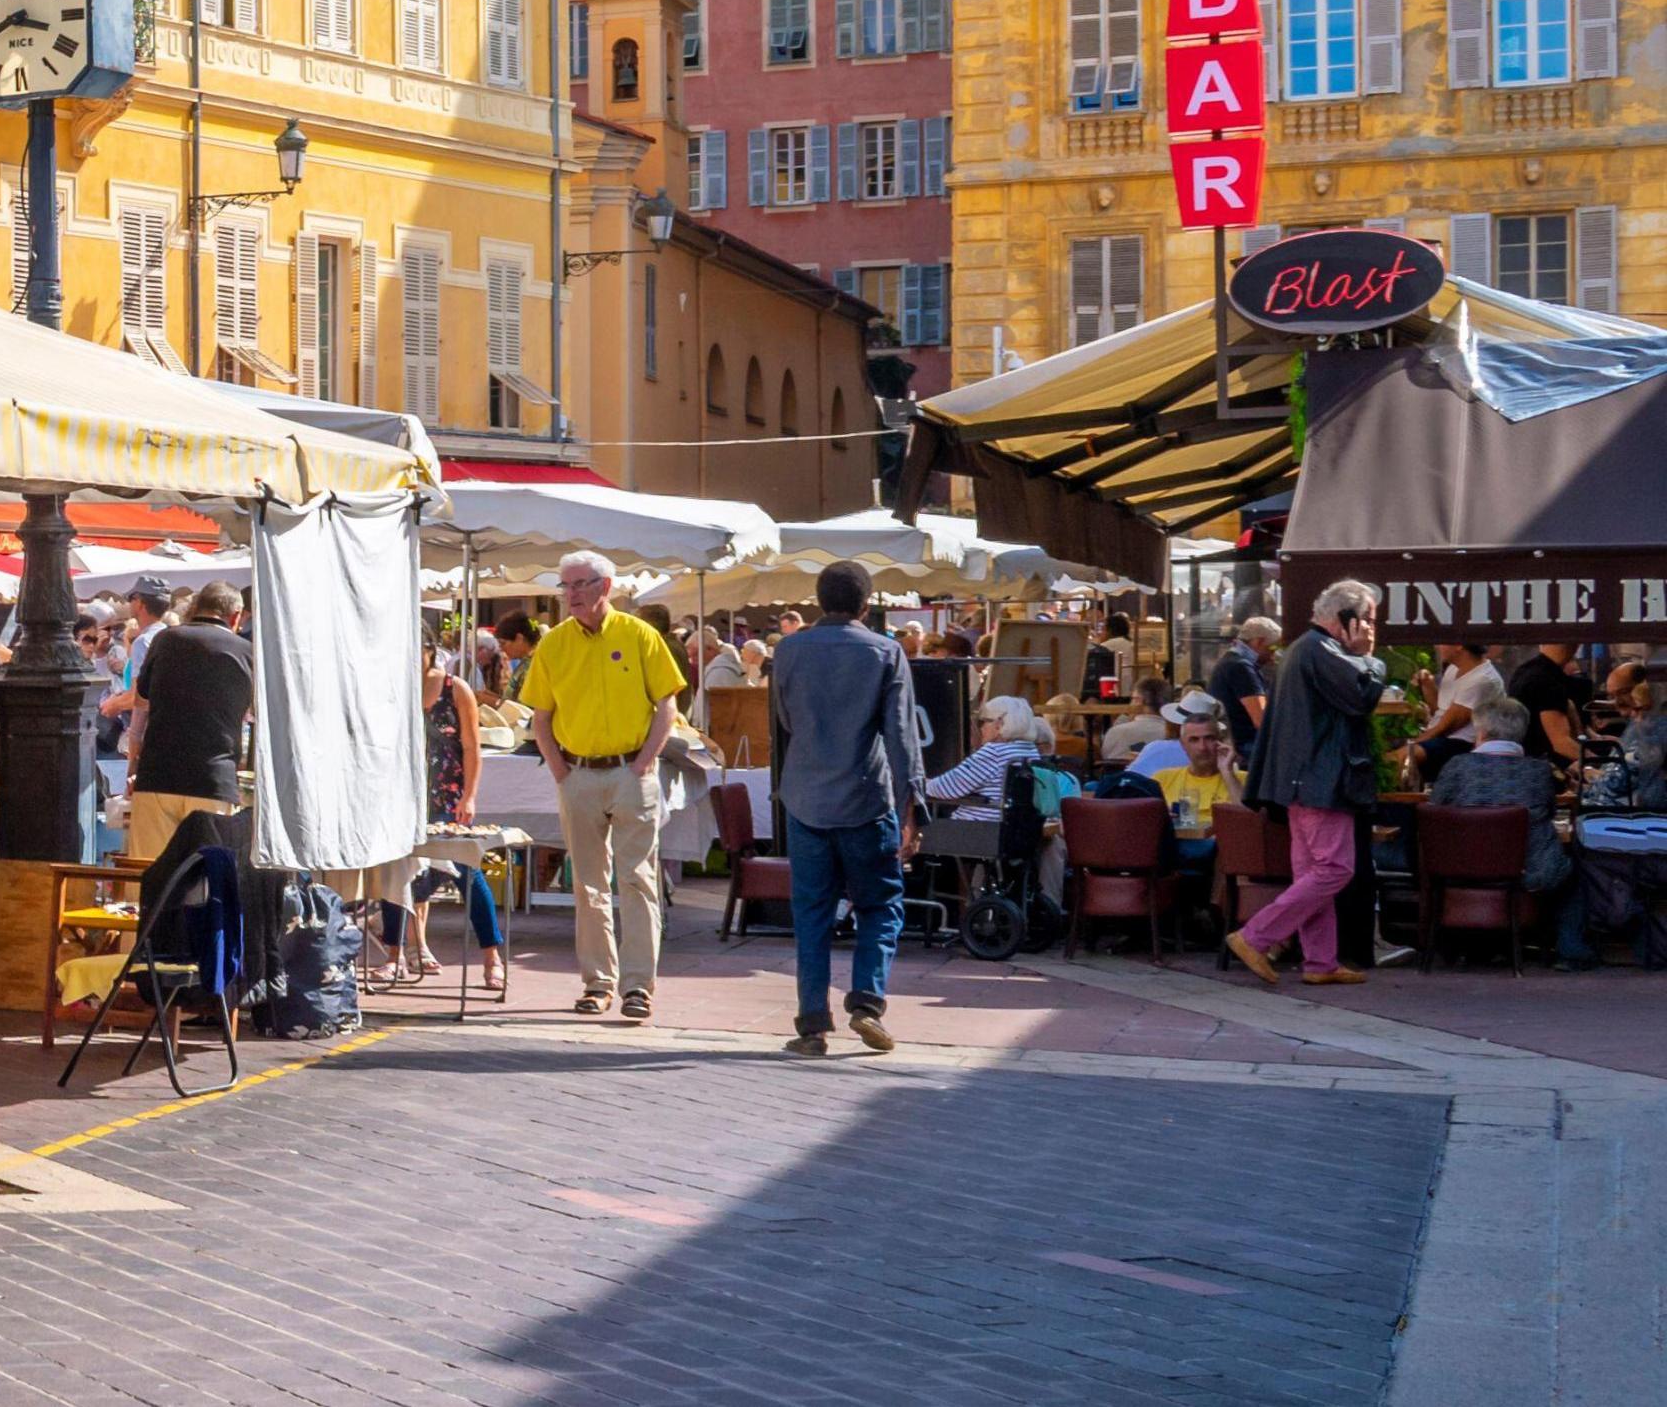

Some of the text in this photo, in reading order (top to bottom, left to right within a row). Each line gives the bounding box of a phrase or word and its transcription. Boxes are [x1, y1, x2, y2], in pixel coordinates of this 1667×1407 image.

[8, 38, 34, 49] NICE
[1264, 250, 1417, 315] Blast
[1364, 578, 1667, 625] INTHE B
